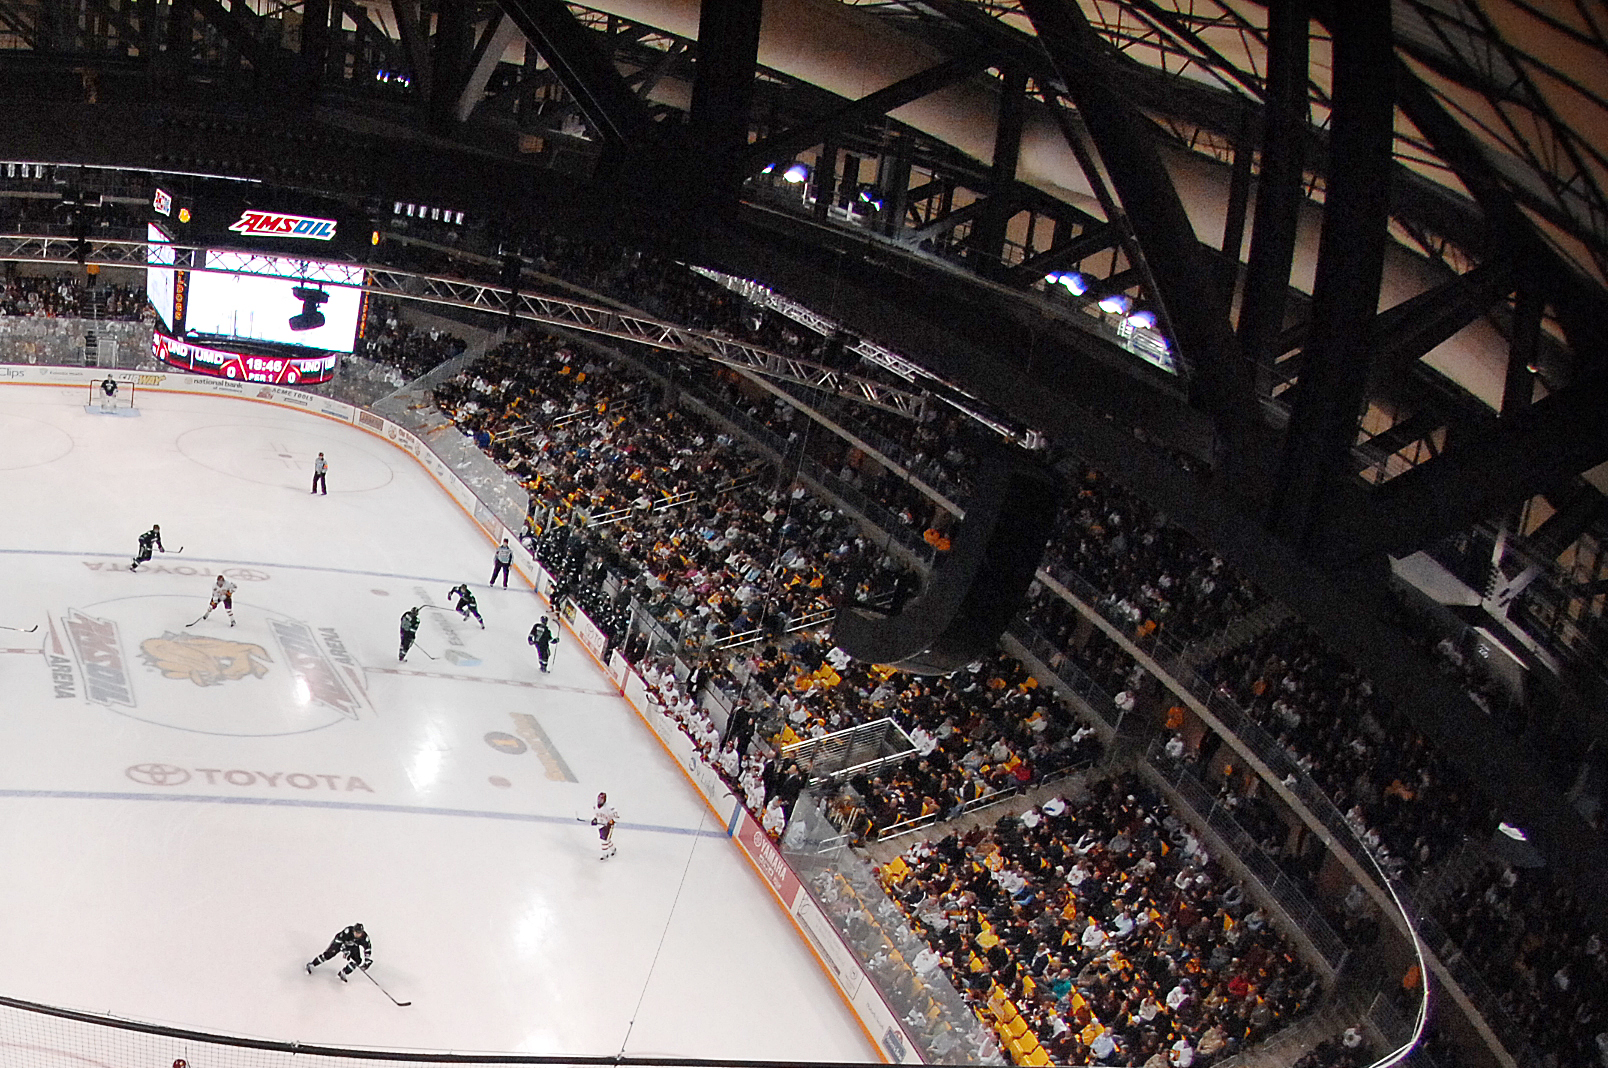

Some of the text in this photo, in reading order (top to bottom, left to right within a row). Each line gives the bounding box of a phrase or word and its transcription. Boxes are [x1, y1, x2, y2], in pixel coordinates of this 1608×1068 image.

[236, 213, 333, 237] AMSOIL
[195, 349, 224, 365] UMD
[226, 366, 236, 378] 0
[246, 358, 282, 372] 18:46
[300, 361, 321, 373] UND
[119, 374, 166, 386] SUBWAY
[193, 378, 242, 389] national bank
[248, 373, 266, 382] PER
[288, 372, 296, 383] 0
[271, 388, 314, 402] ACME TOOLS
[318, 627, 354, 666] ARENA
[67, 612, 131, 703] AMSOIL
[50, 654, 76, 699] ARENA
[195, 768, 375, 793] TOYOTA
[760, 837, 788, 881] YAMAHA
